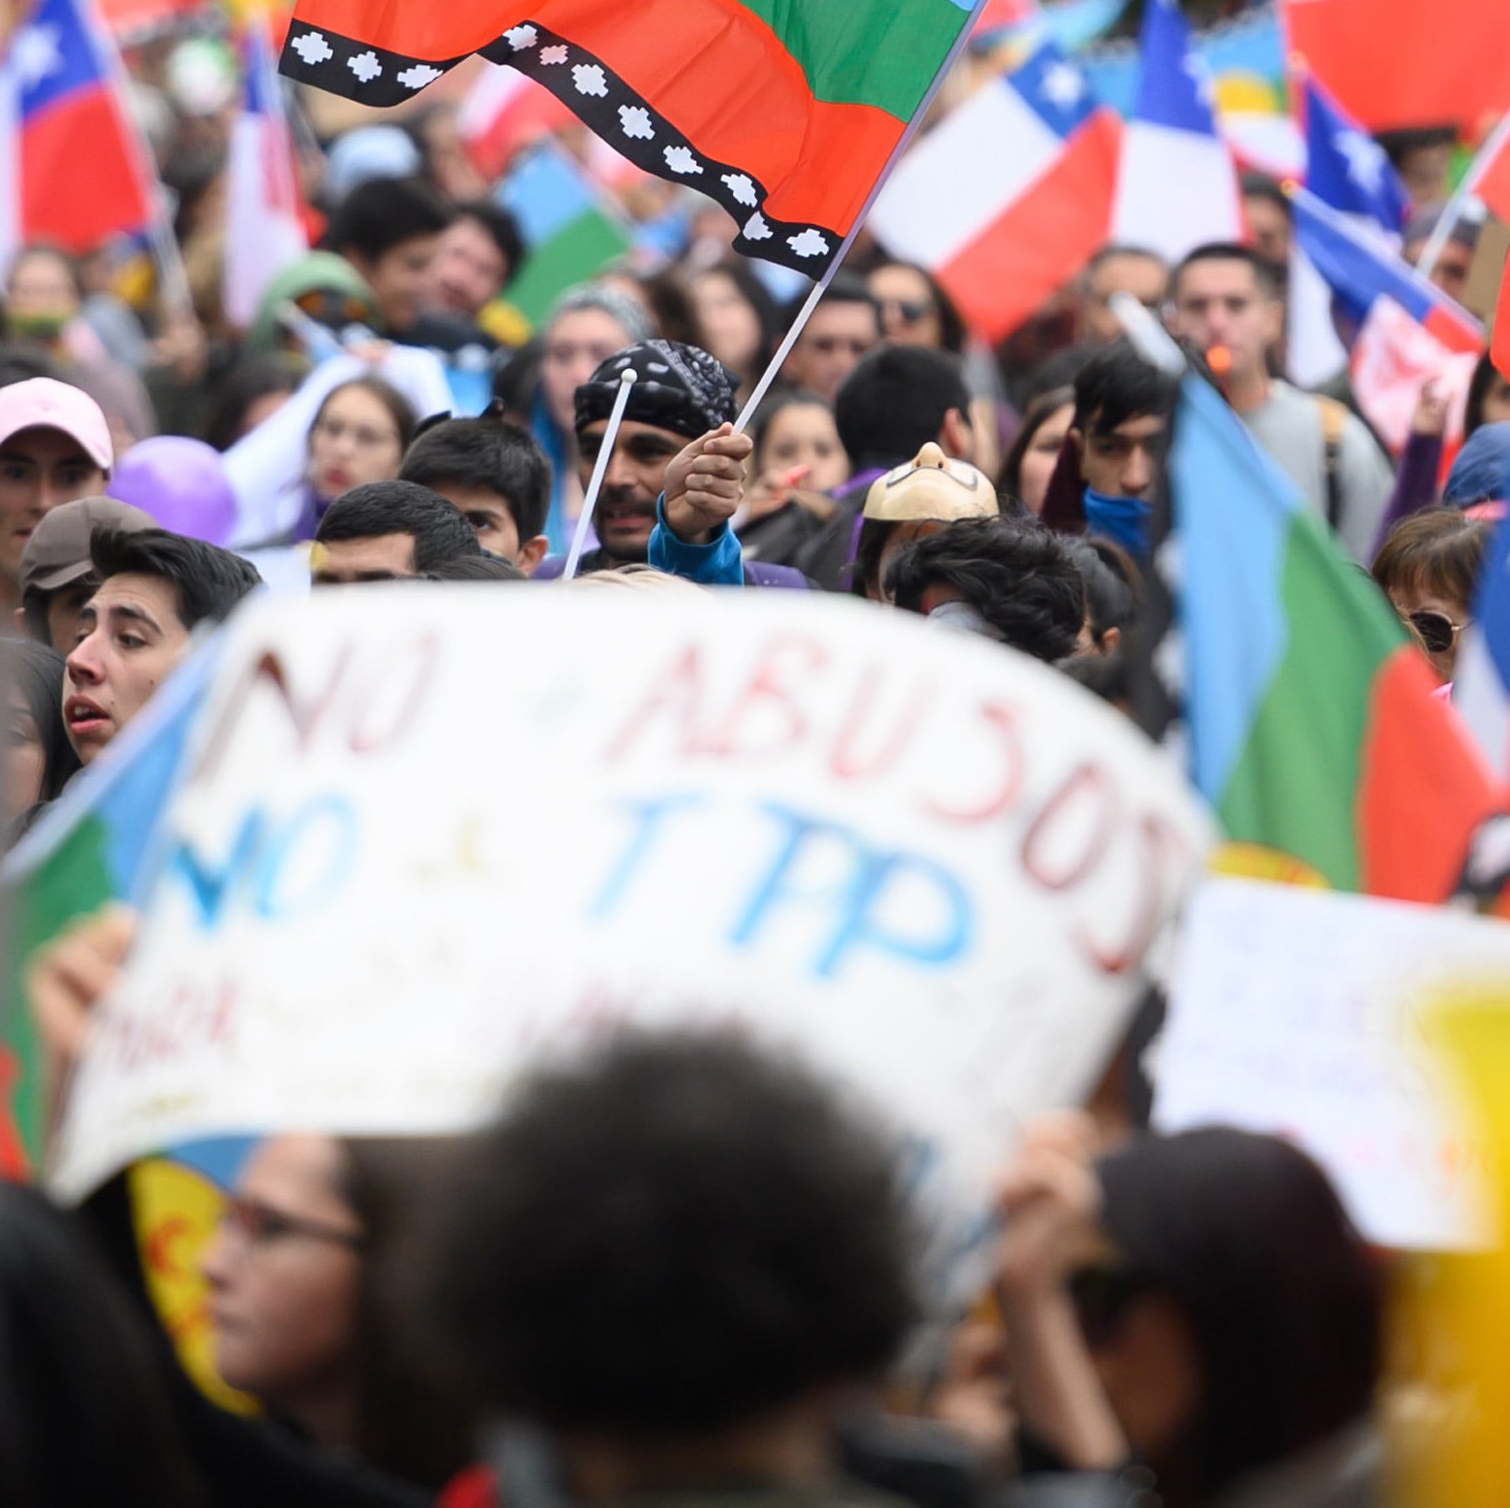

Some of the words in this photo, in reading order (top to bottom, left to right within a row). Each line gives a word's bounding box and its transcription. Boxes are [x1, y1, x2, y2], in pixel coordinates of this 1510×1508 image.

[169, 786, 361, 934] NO
[583, 792, 977, 984] TPP
[195, 620, 441, 782] NO
[599, 626, 1191, 980] ABUSOS
